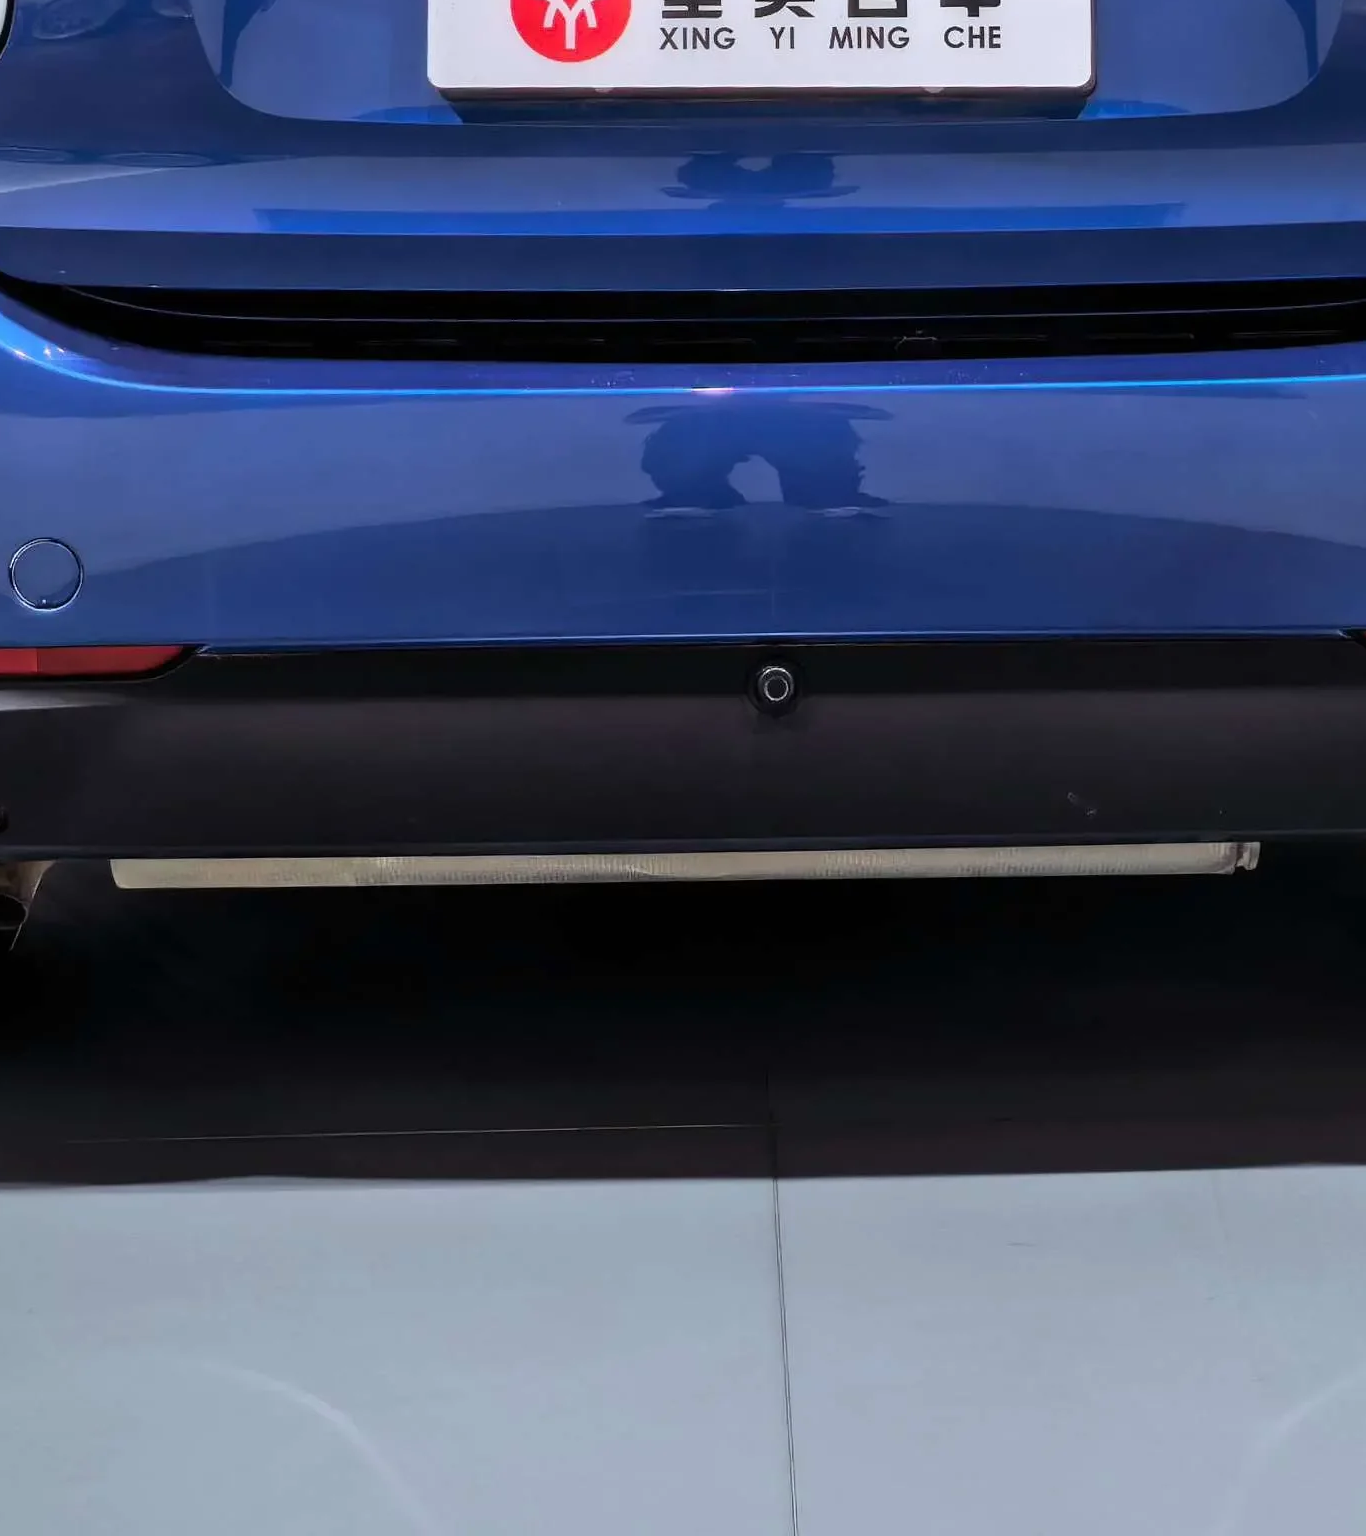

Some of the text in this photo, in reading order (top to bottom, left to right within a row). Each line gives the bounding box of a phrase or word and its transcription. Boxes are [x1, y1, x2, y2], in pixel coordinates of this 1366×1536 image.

[659, 26, 1002, 50] XING YI MING CHE
